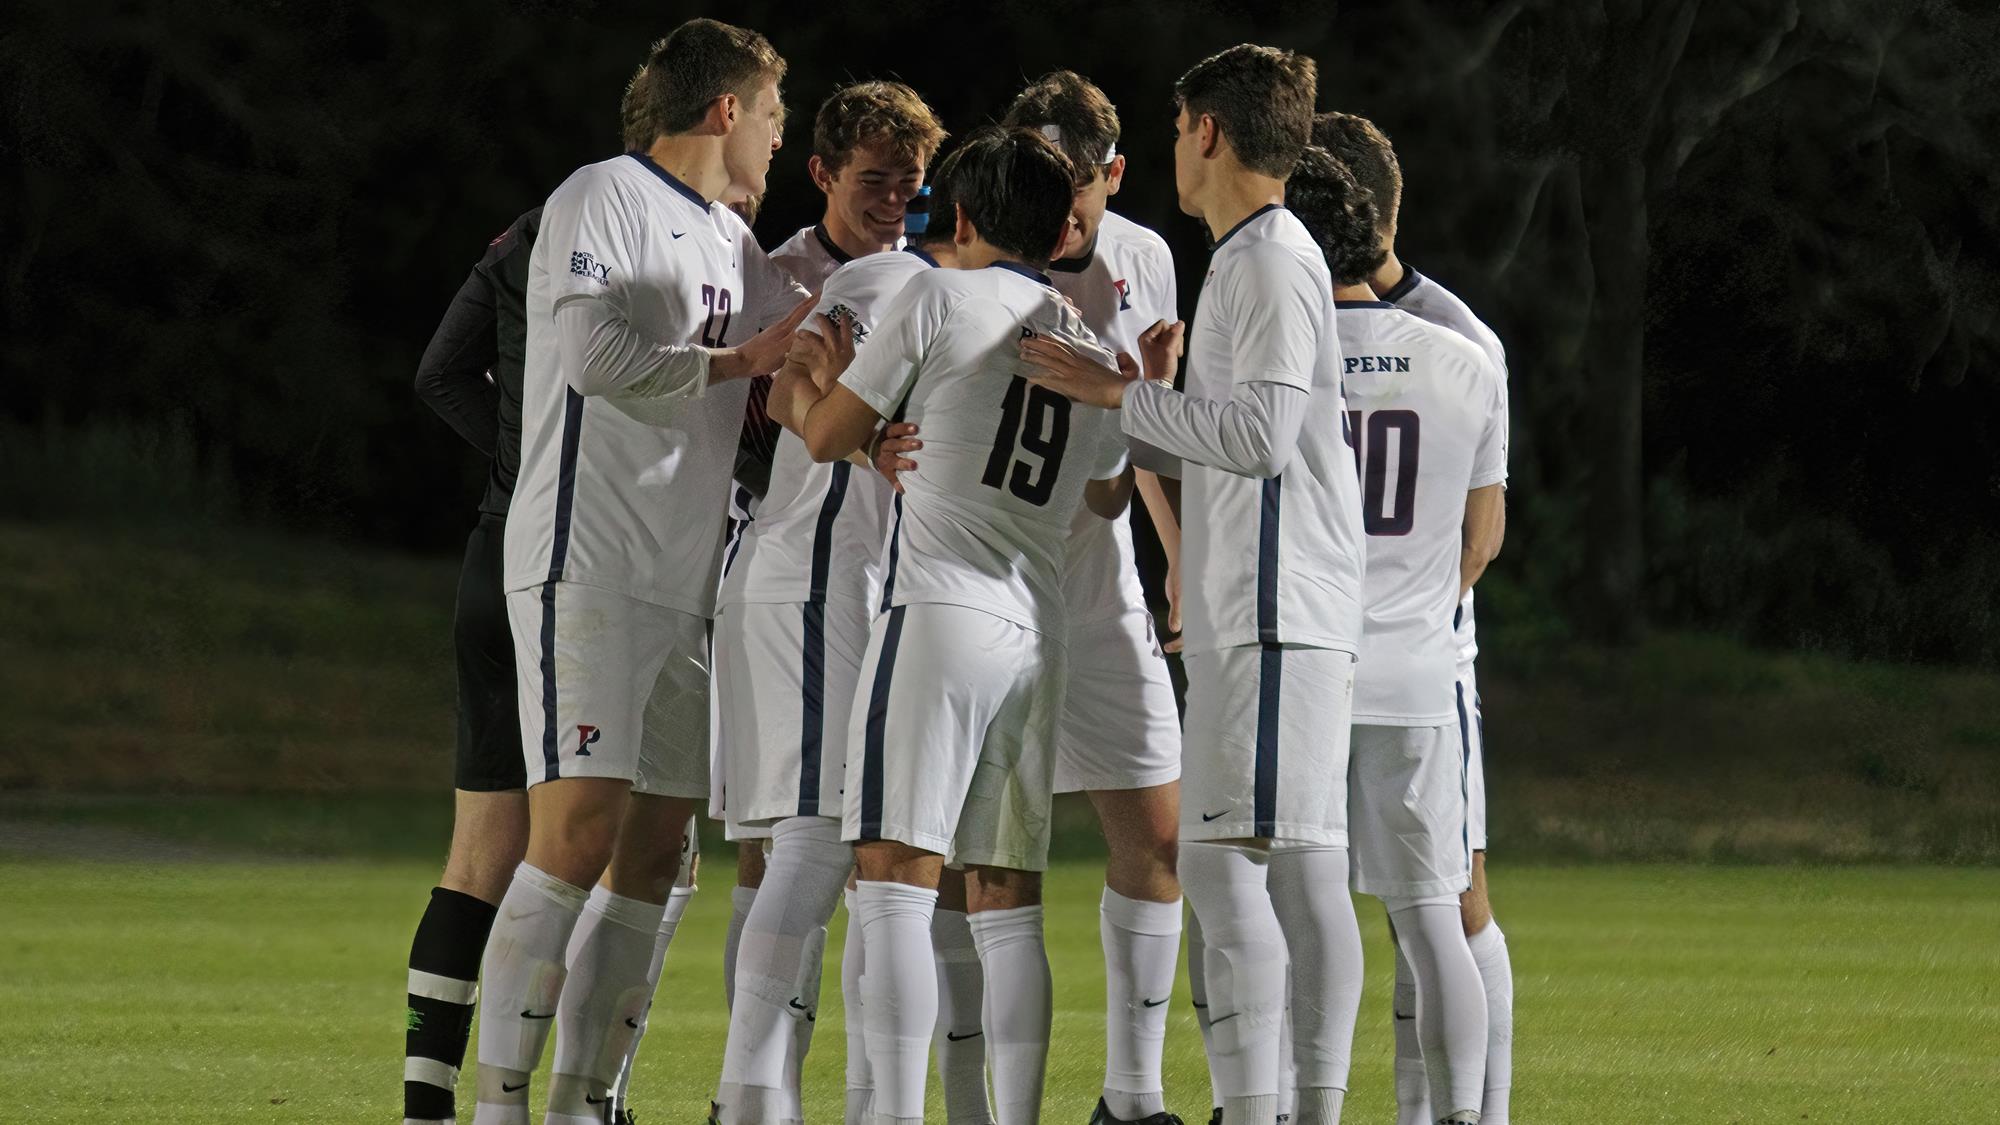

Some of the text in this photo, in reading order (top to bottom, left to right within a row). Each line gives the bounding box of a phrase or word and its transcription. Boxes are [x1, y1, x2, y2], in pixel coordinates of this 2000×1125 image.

[582, 256, 612, 279] IVY
[1113, 278, 1132, 311] P
[702, 283, 731, 348] 22
[1344, 356, 1411, 374] PENN
[981, 374, 1072, 507] 19
[575, 724, 601, 756] P
